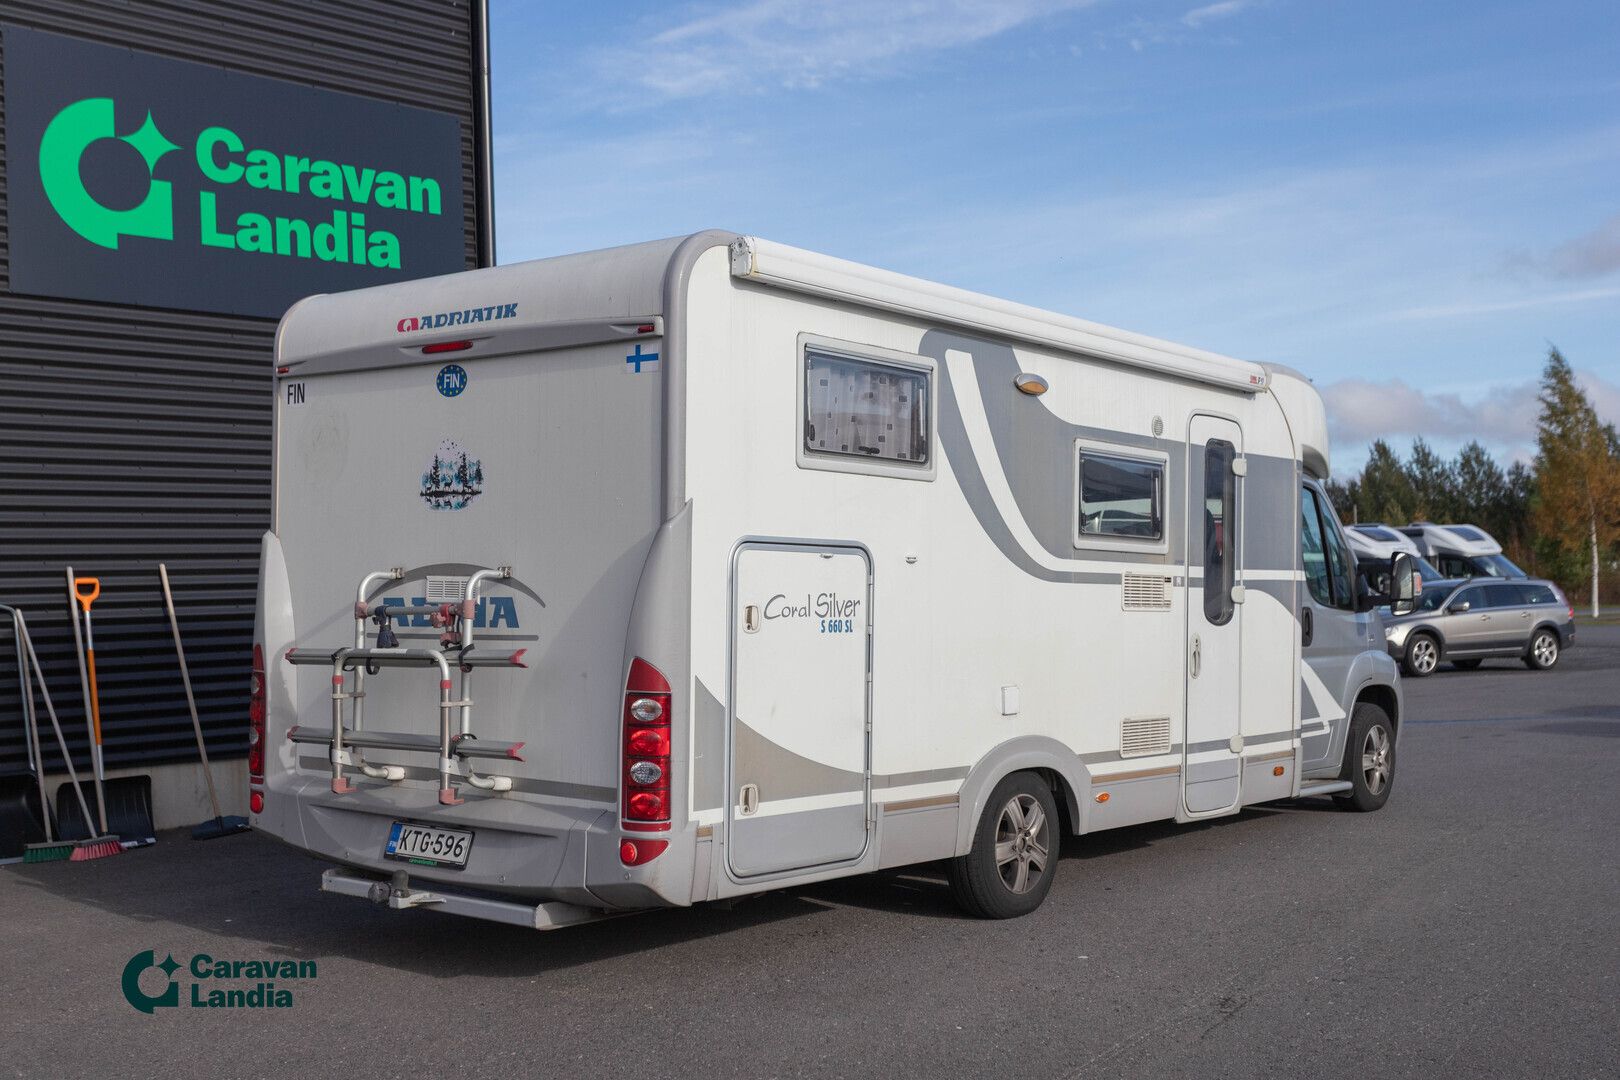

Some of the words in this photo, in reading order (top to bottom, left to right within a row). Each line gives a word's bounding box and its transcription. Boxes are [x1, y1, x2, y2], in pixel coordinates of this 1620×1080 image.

[195, 126, 442, 215] Caravan
[199, 190, 402, 269] Landia
[419, 303, 519, 330] ADRIATIK
[287, 382, 305, 405] FIN
[443, 373, 461, 389] FIN
[763, 593, 811, 620] Coral
[814, 592, 861, 618] Silver
[820, 620, 826, 633] S
[828, 620, 843, 633] 660
[844, 620, 853, 633] SL
[399, 828, 466, 858] KTG-596
